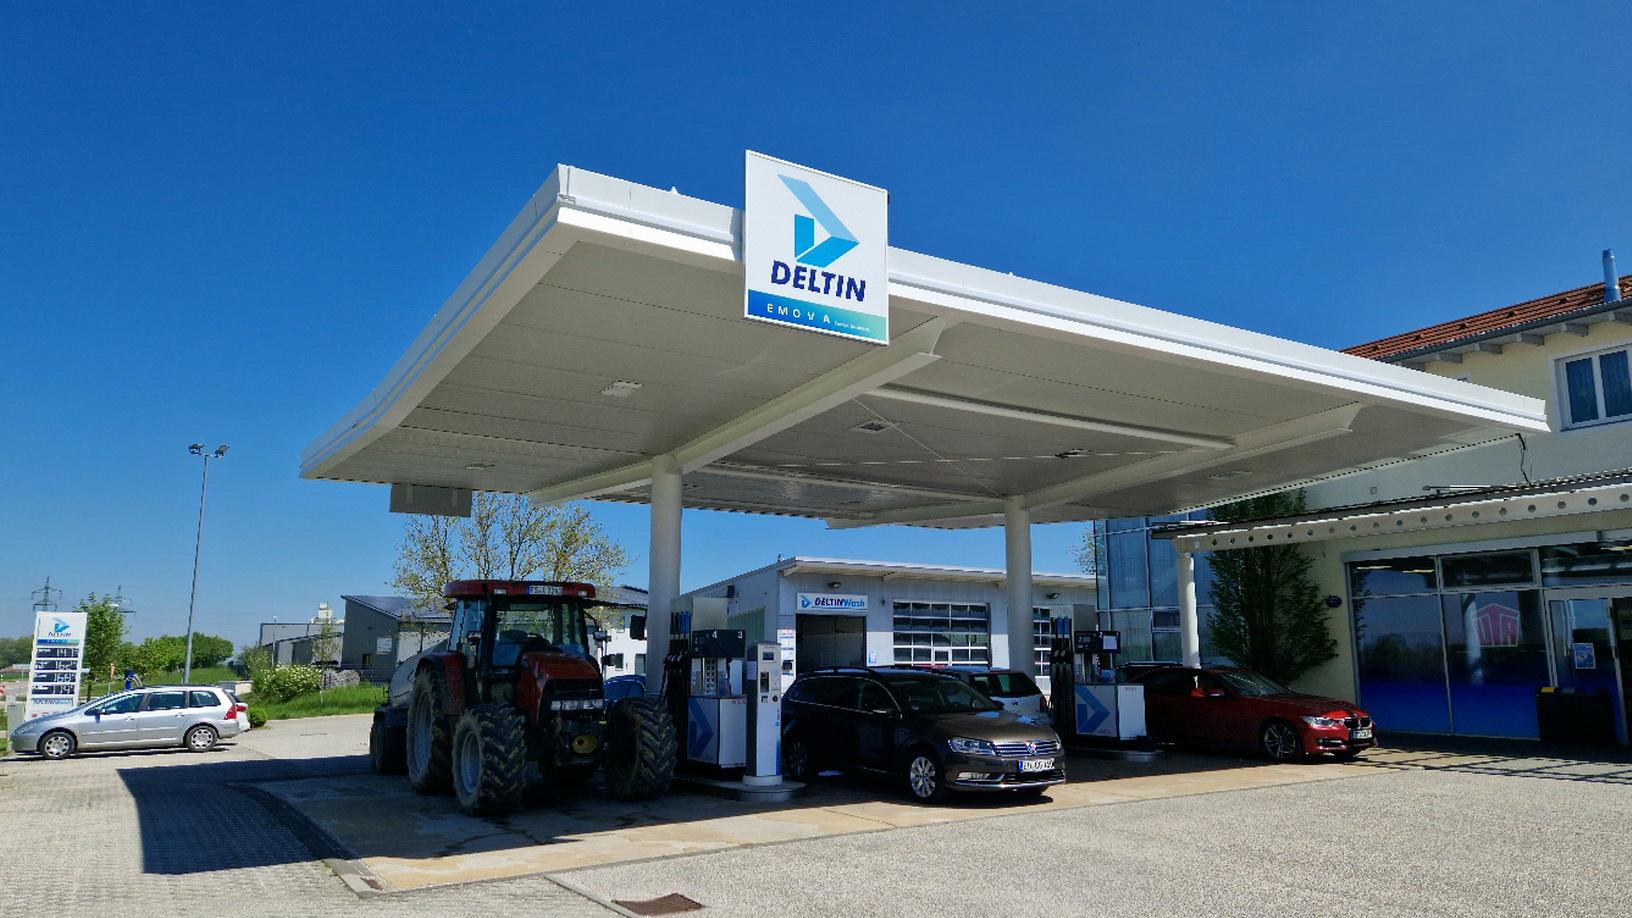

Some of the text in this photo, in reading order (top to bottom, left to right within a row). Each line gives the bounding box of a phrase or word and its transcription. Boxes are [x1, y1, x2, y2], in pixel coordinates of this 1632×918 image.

[771, 260, 866, 302] DELTIN
[767, 303, 830, 324] EMOVA
[712, 630, 718, 639] 4
